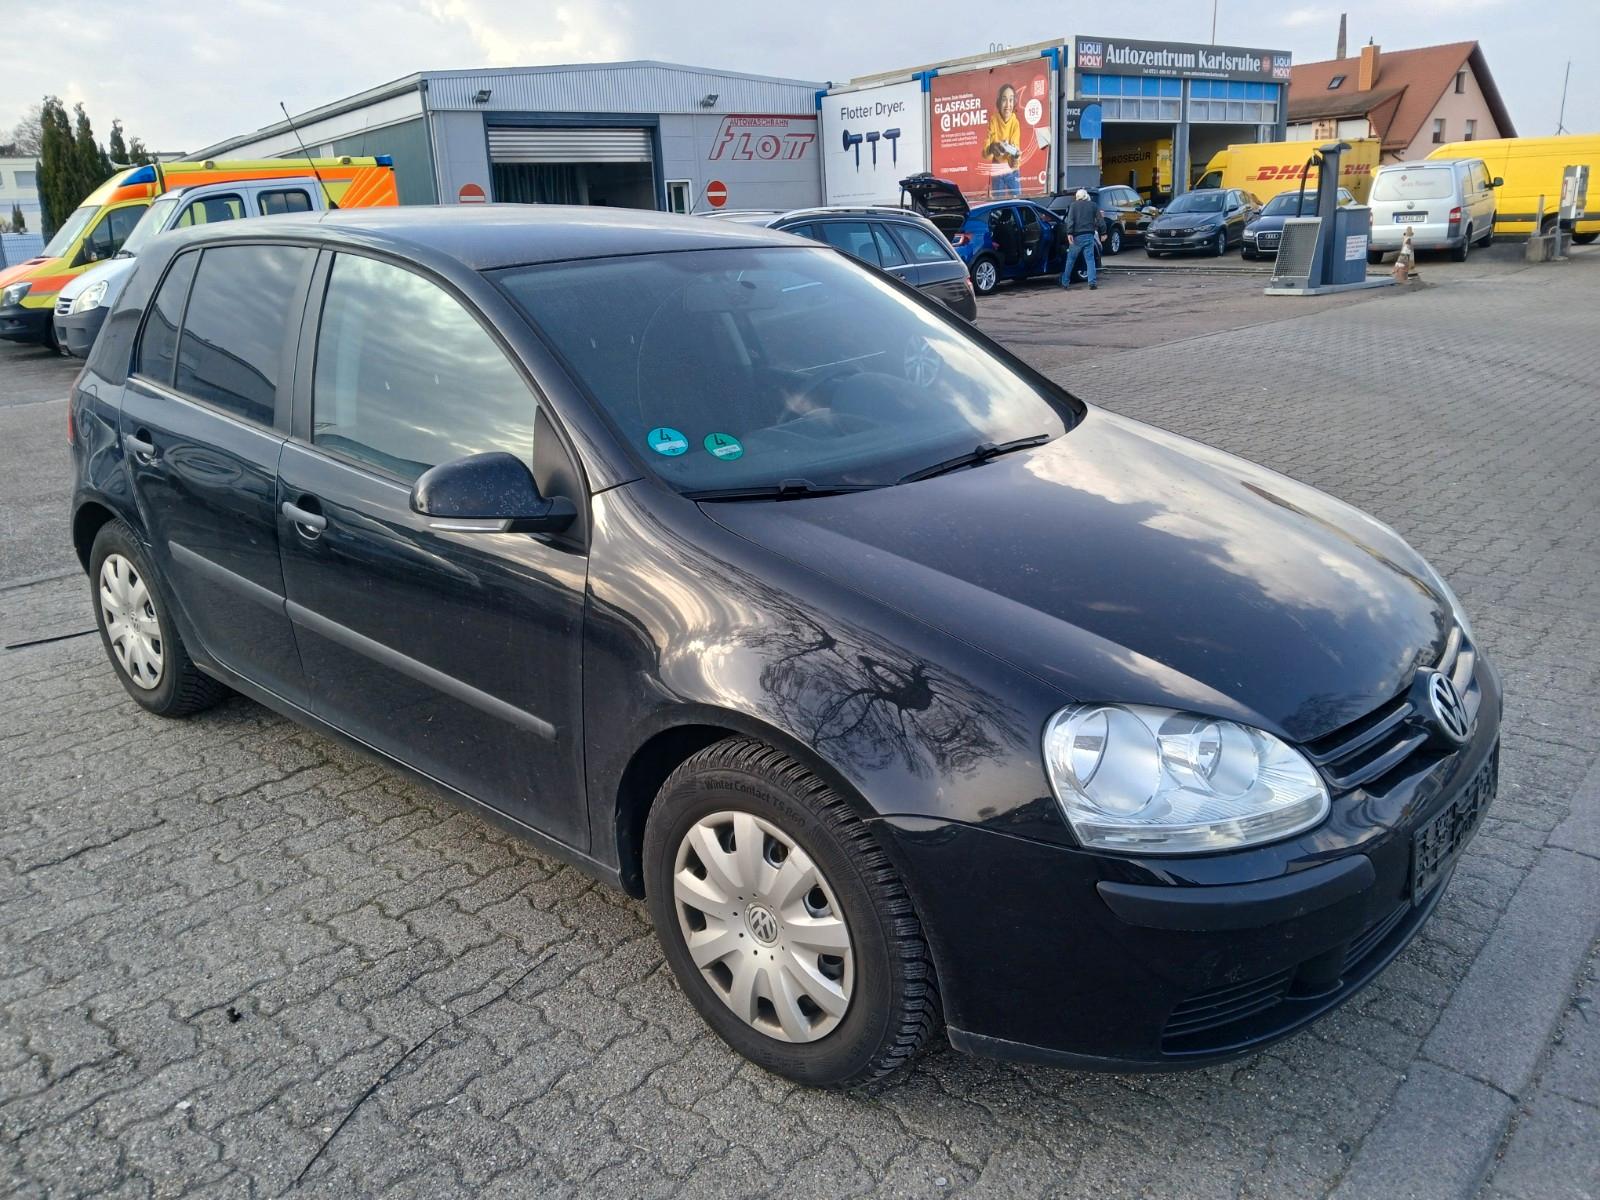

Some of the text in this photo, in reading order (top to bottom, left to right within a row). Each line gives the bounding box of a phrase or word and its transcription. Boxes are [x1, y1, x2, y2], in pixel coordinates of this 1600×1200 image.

[1079, 43, 1101, 54] LIQUI
[1079, 54, 1102, 66] MOLY
[1106, 44, 1261, 72] Autozentrum Karlsruhe
[1273, 56, 1291, 67] LIQUI
[1272, 67, 1291, 77] MOLY
[840, 101, 905, 120] Flotter Dryer.
[934, 98, 981, 114] GLASFASER
[708, 113, 816, 160] FLOTT
[1256, 164, 1315, 181] DHL
[1344, 163, 1370, 175] DHL
[660, 428, 671, 441] 4
[713, 433, 726, 446] 4
